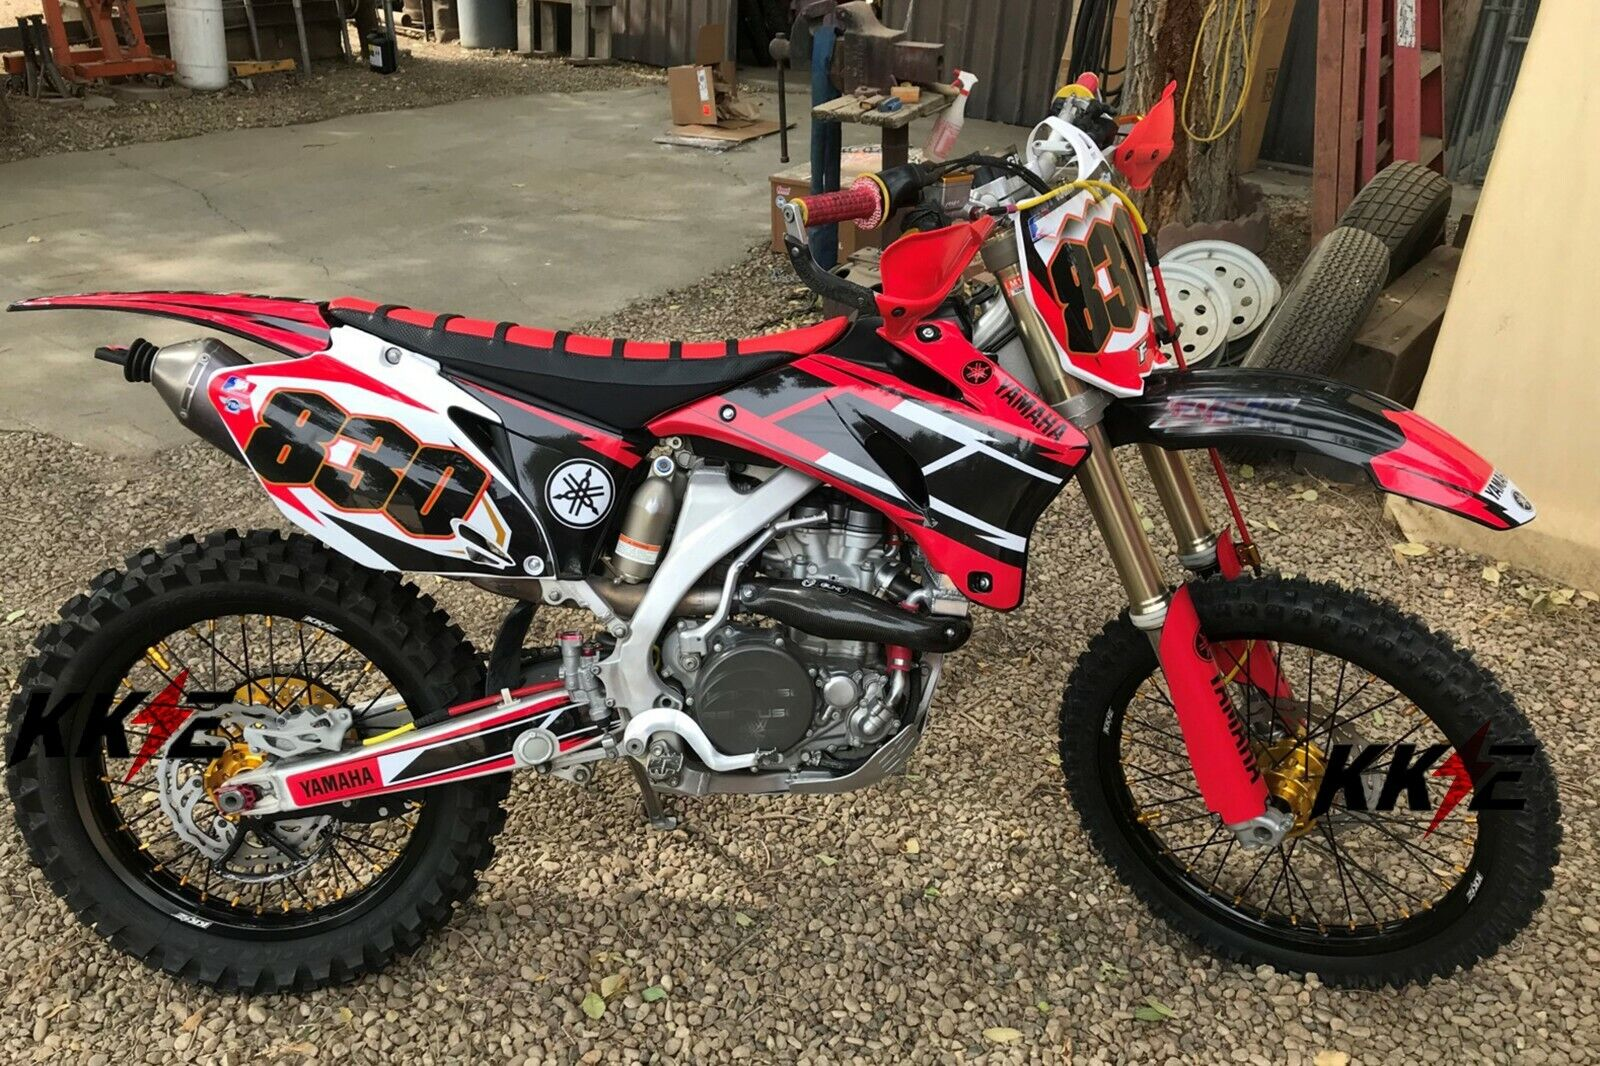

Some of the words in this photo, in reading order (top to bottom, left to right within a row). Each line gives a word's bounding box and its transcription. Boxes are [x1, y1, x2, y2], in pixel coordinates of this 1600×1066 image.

[994, 377, 1068, 441] YAMAHA
[245, 387, 493, 540] 830
[299, 766, 375, 798] YAMAHA
